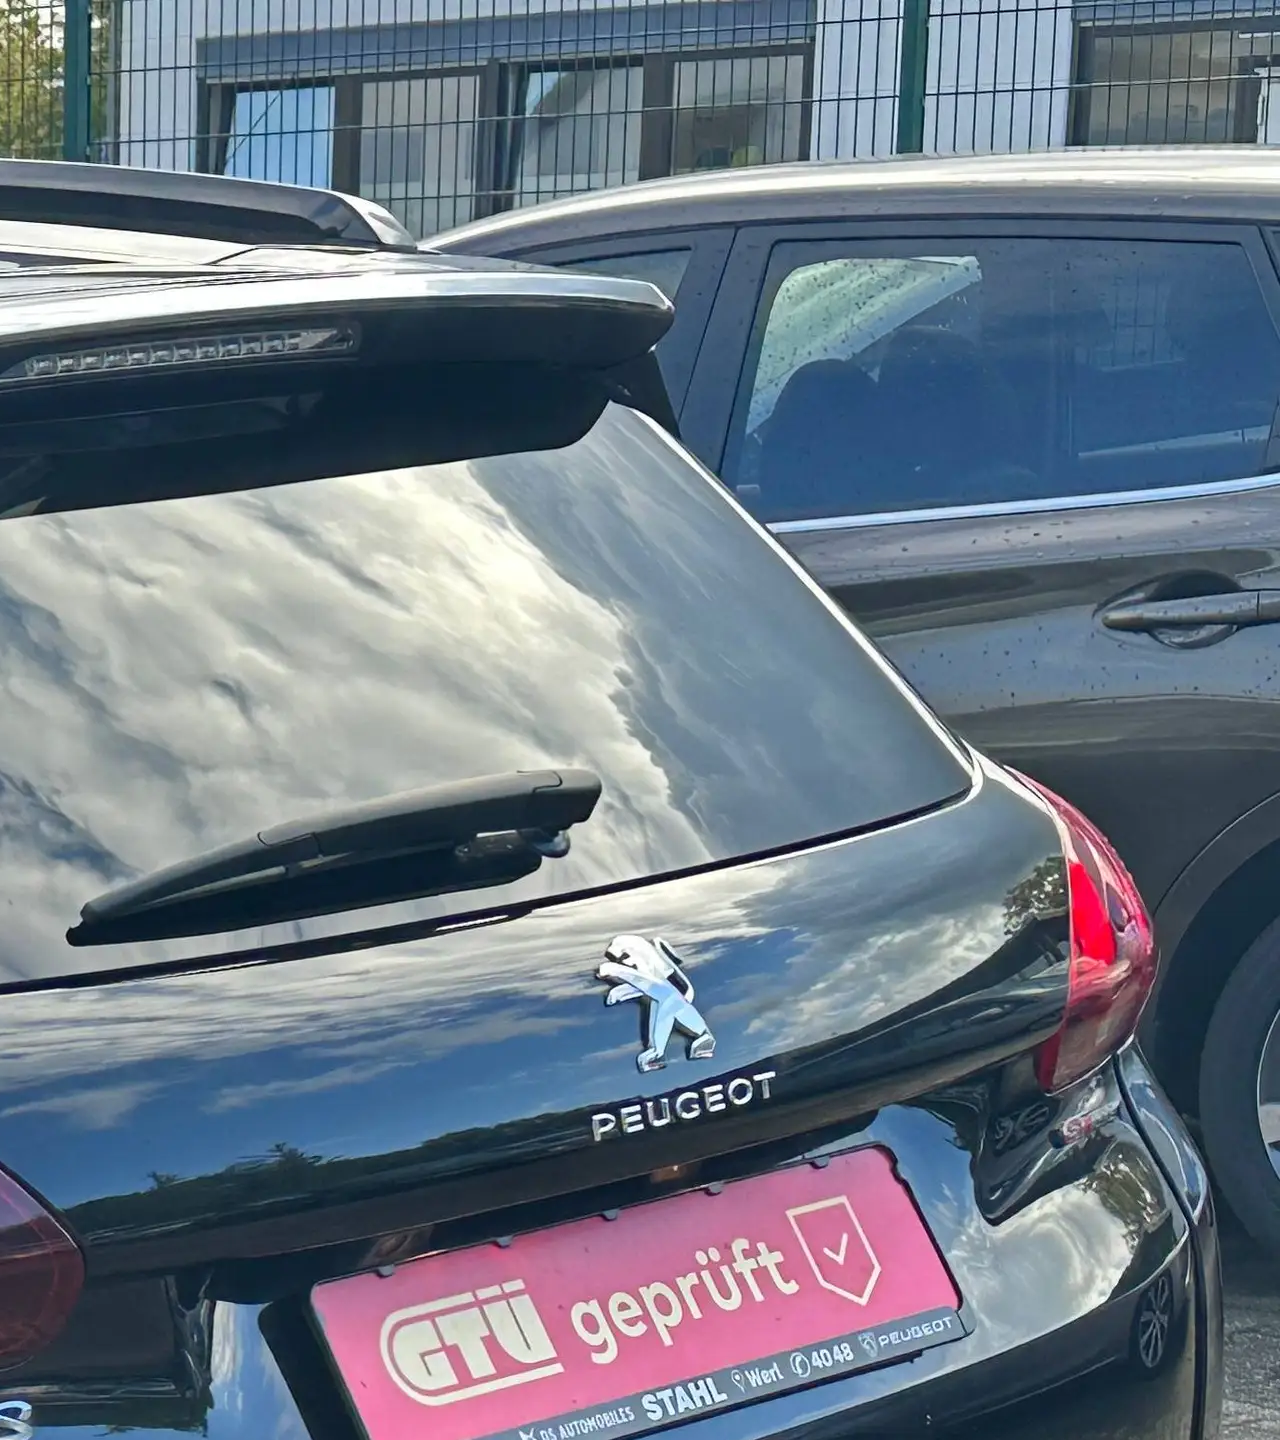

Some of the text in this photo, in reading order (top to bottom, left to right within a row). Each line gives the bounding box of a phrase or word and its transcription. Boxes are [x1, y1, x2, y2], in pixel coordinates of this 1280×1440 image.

[592, 1071, 776, 1142] PEUGEOT
[380, 1237, 800, 1405] GTÜ geprüft
[558, 1405, 635, 1440] AUTOMOBILES
[641, 1377, 728, 1422] STAHL
[744, 1362, 784, 1389] Werl
[810, 1342, 854, 1370] 4048
[878, 1316, 953, 1348] PEUGEOT
